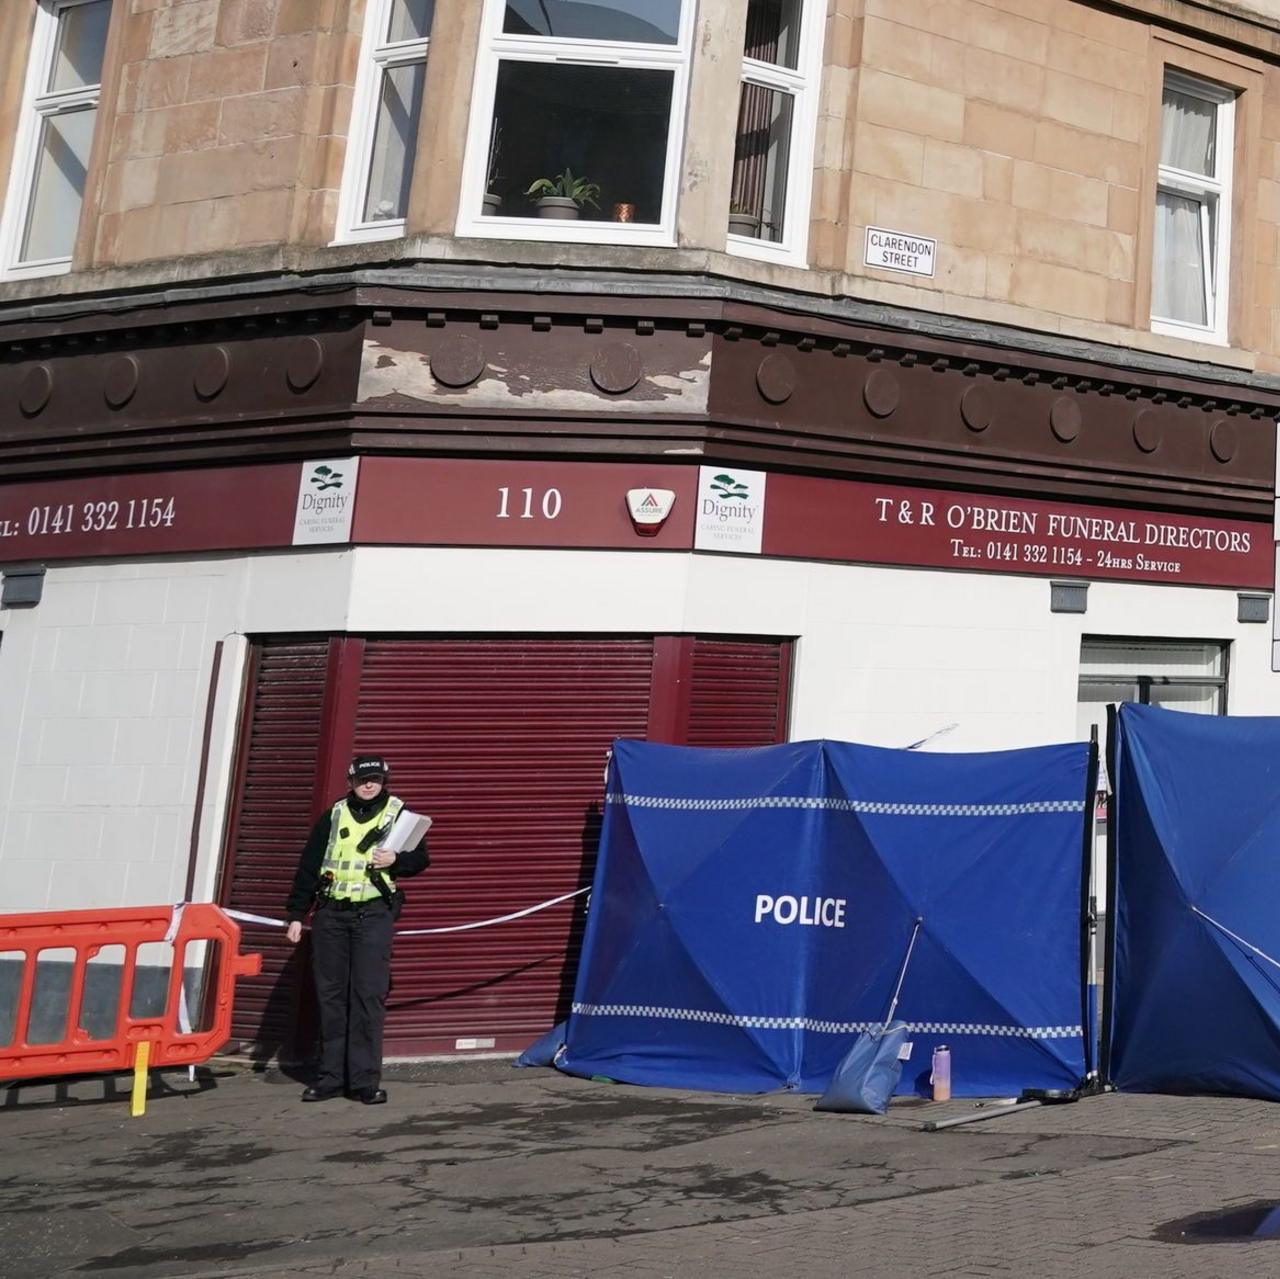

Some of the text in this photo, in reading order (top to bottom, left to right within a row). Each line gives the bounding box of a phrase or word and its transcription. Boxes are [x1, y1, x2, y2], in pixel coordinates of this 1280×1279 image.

[871, 234, 931, 256] CLARENDON
[882, 251, 918, 268] STREET
[302, 493, 347, 515] Dignity
[496, 487, 562, 519] 110
[703, 499, 756, 524] Dignity
[28, 504, 74, 536] 0141
[81, 501, 119, 532] 332
[126, 497, 175, 529] 1154
[875, 498, 1251, 553] T & R O'BRIEN FUNERAL DIRECTORS
[986, 541, 1018, 561] 0141
[1023, 544, 1047, 563] 332
[1052, 547, 1083, 566] 1154
[755, 894, 847, 928] POLICE
